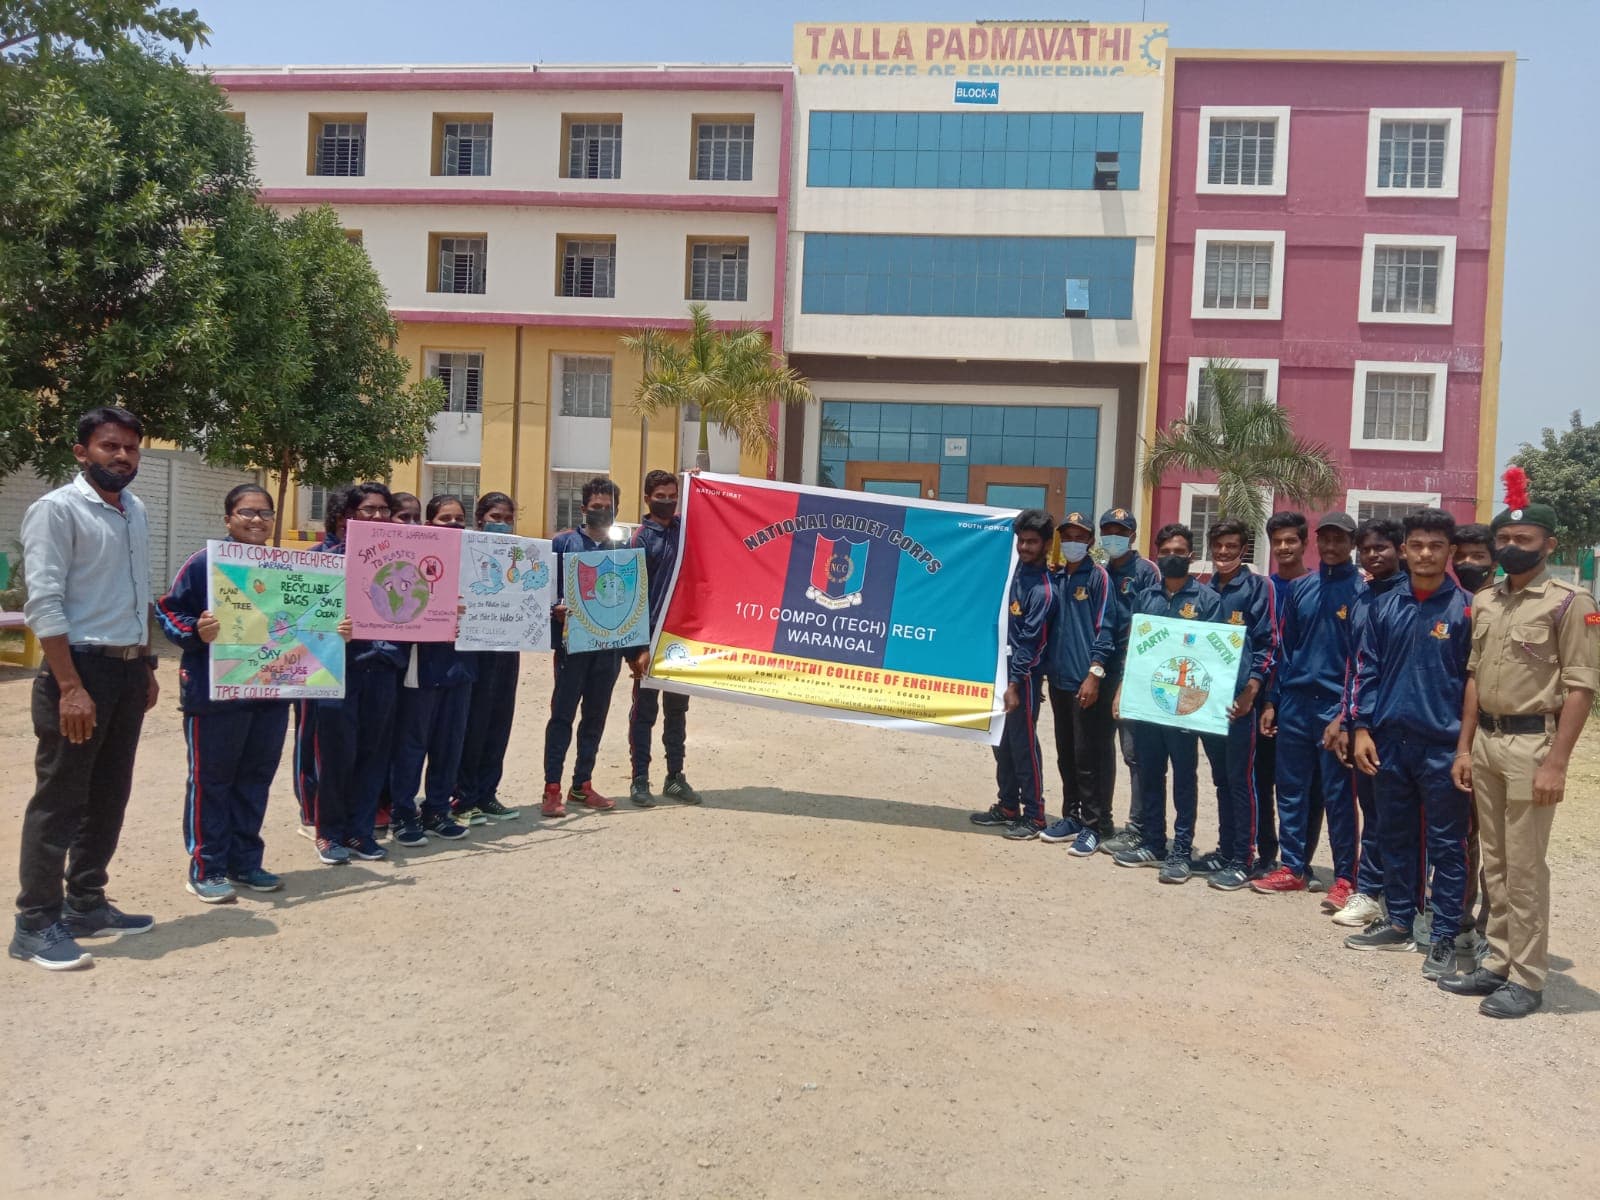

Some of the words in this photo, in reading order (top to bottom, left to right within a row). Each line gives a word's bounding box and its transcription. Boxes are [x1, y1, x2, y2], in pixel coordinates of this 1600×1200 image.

[805, 27, 914, 60] TALLA
[925, 27, 1132, 61] PADMAVATHI
[956, 87, 997, 99] BLOCK-A
[695, 487, 720, 497] NATION
[722, 491, 742, 500] FIRST
[958, 521, 982, 530] YOUTH
[742, 513, 828, 551] NATIONAL
[832, 513, 889, 538] CADET
[888, 527, 943, 574] CORPS
[218, 543, 243, 559] 1(T)
[358, 545, 377, 564] SAY
[378, 540, 390, 551] NO
[371, 559, 383, 569] TO
[831, 562, 848, 573] NCC
[286, 574, 304, 582] USE
[281, 581, 330, 594] RECYCLABLE
[231, 602, 252, 610] TREE
[283, 594, 309, 607] BAGS
[319, 597, 342, 608] SAVE
[315, 609, 338, 618] OCEAN
[734, 601, 764, 620] 1(T)
[769, 607, 827, 626] COMPO
[832, 615, 886, 636] (TECH)
[892, 623, 936, 642] REGT
[787, 628, 876, 653] WARANGAL
[1136, 626, 1170, 655] EARTH
[257, 646, 281, 660] SAY
[248, 659, 258, 667] TO
[703, 646, 738, 662] TALA
[742, 652, 822, 676] PADMAVATHI
[826, 666, 879, 684] COLLEGE
[883, 673, 900, 686] OF
[903, 676, 989, 699] ENGINEERING
